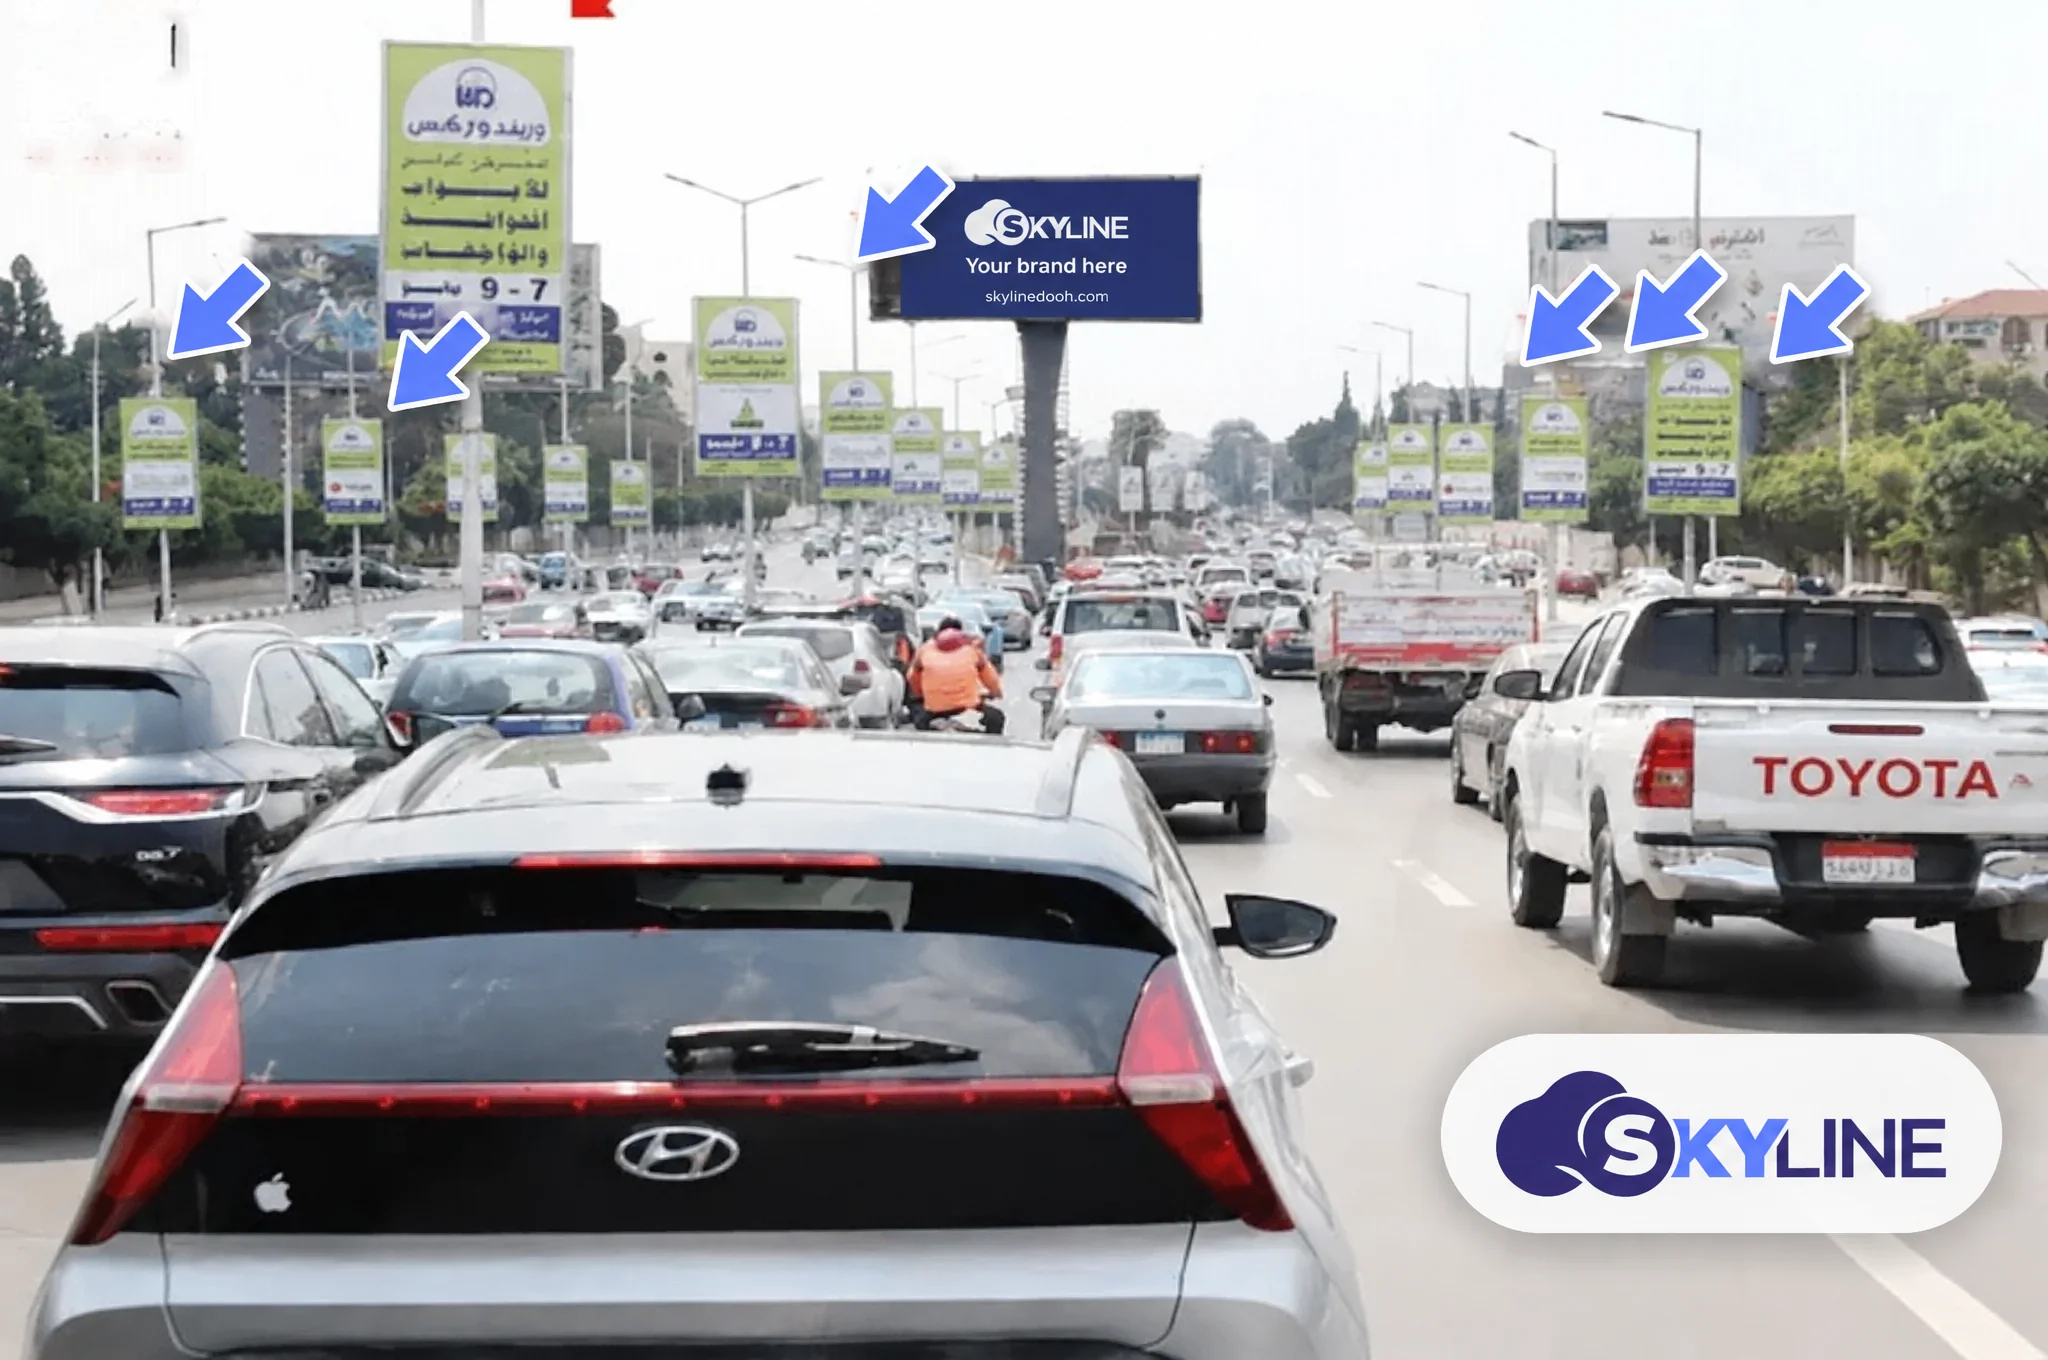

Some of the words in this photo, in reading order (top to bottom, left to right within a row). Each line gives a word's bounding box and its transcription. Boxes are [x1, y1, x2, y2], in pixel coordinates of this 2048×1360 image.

[1002, 214, 1129, 239] SKYLINE
[965, 257, 1012, 274] Your
[1017, 257, 1076, 274] brand
[1082, 257, 1127, 274] here
[481, 276, 499, 300] 9
[529, 278, 548, 301] 7
[985, 290, 1109, 306] skylinedooh.com
[1753, 756, 1999, 800] TOYOTA
